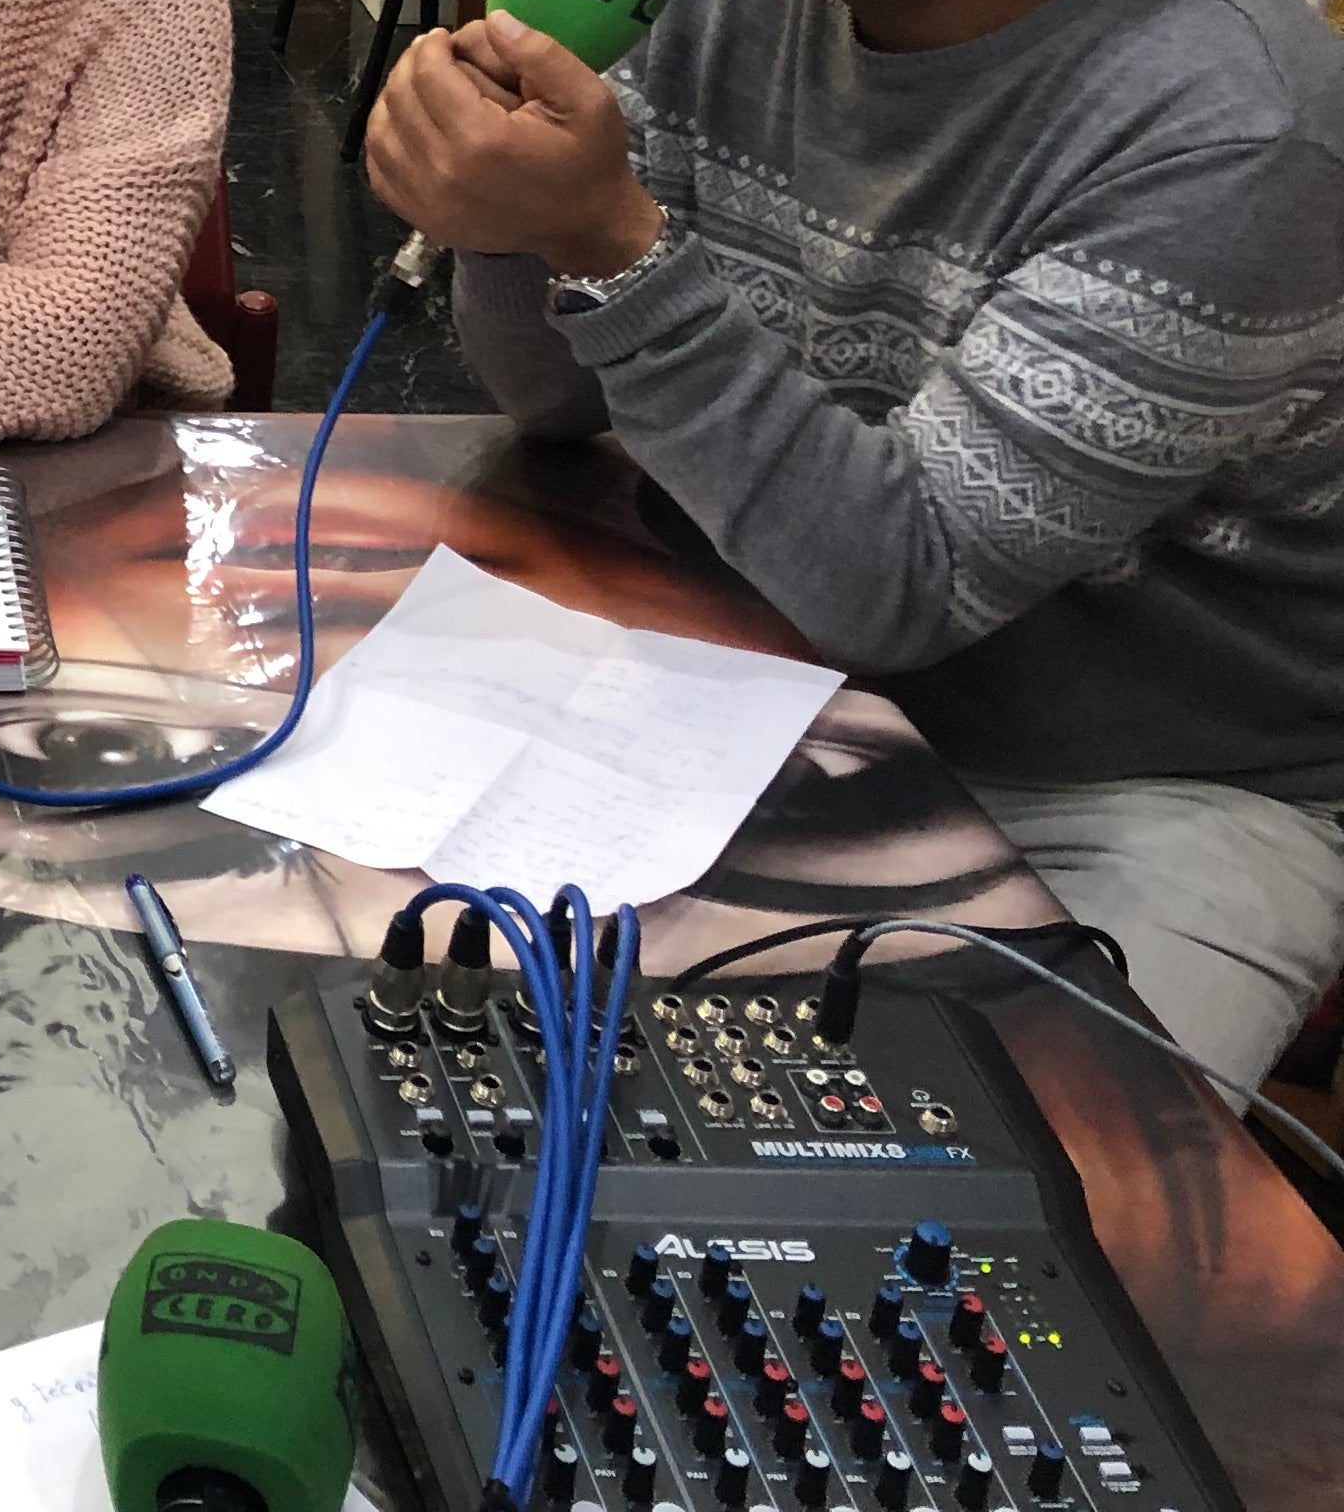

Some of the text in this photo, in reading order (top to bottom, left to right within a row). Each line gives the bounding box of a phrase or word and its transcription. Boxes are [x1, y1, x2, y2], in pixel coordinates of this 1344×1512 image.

[750, 1140, 908, 1160] MULTIMIX8
[944, 1146, 976, 1160] FX
[655, 1233, 816, 1262] ALESIS
[168, 1266, 275, 1296] ONDA
[168, 1295, 274, 1330] CERO
